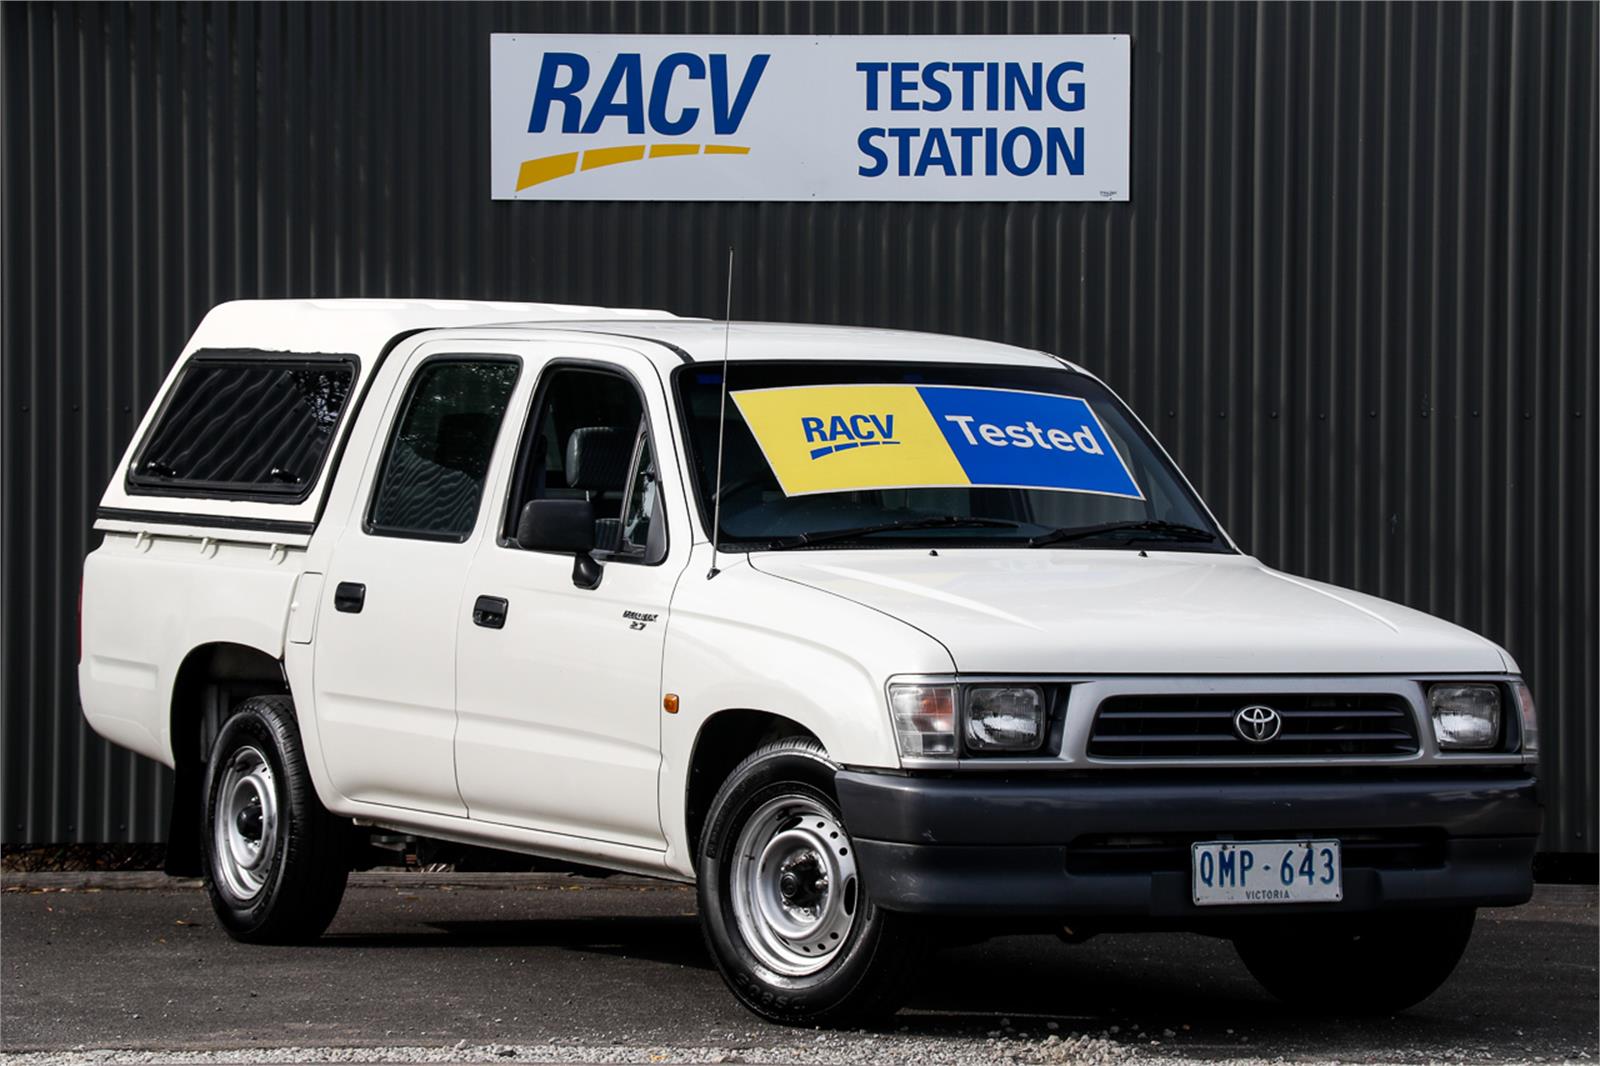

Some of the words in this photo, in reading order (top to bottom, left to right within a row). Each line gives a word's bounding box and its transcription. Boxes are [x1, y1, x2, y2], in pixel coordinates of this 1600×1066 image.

[527, 51, 771, 136] RACV
[855, 61, 1087, 112] TESTING
[857, 126, 1086, 177] STATION
[801, 414, 895, 443] RACV
[944, 413, 1105, 457] Tested
[1245, 889, 1291, 900] VICTORIA
